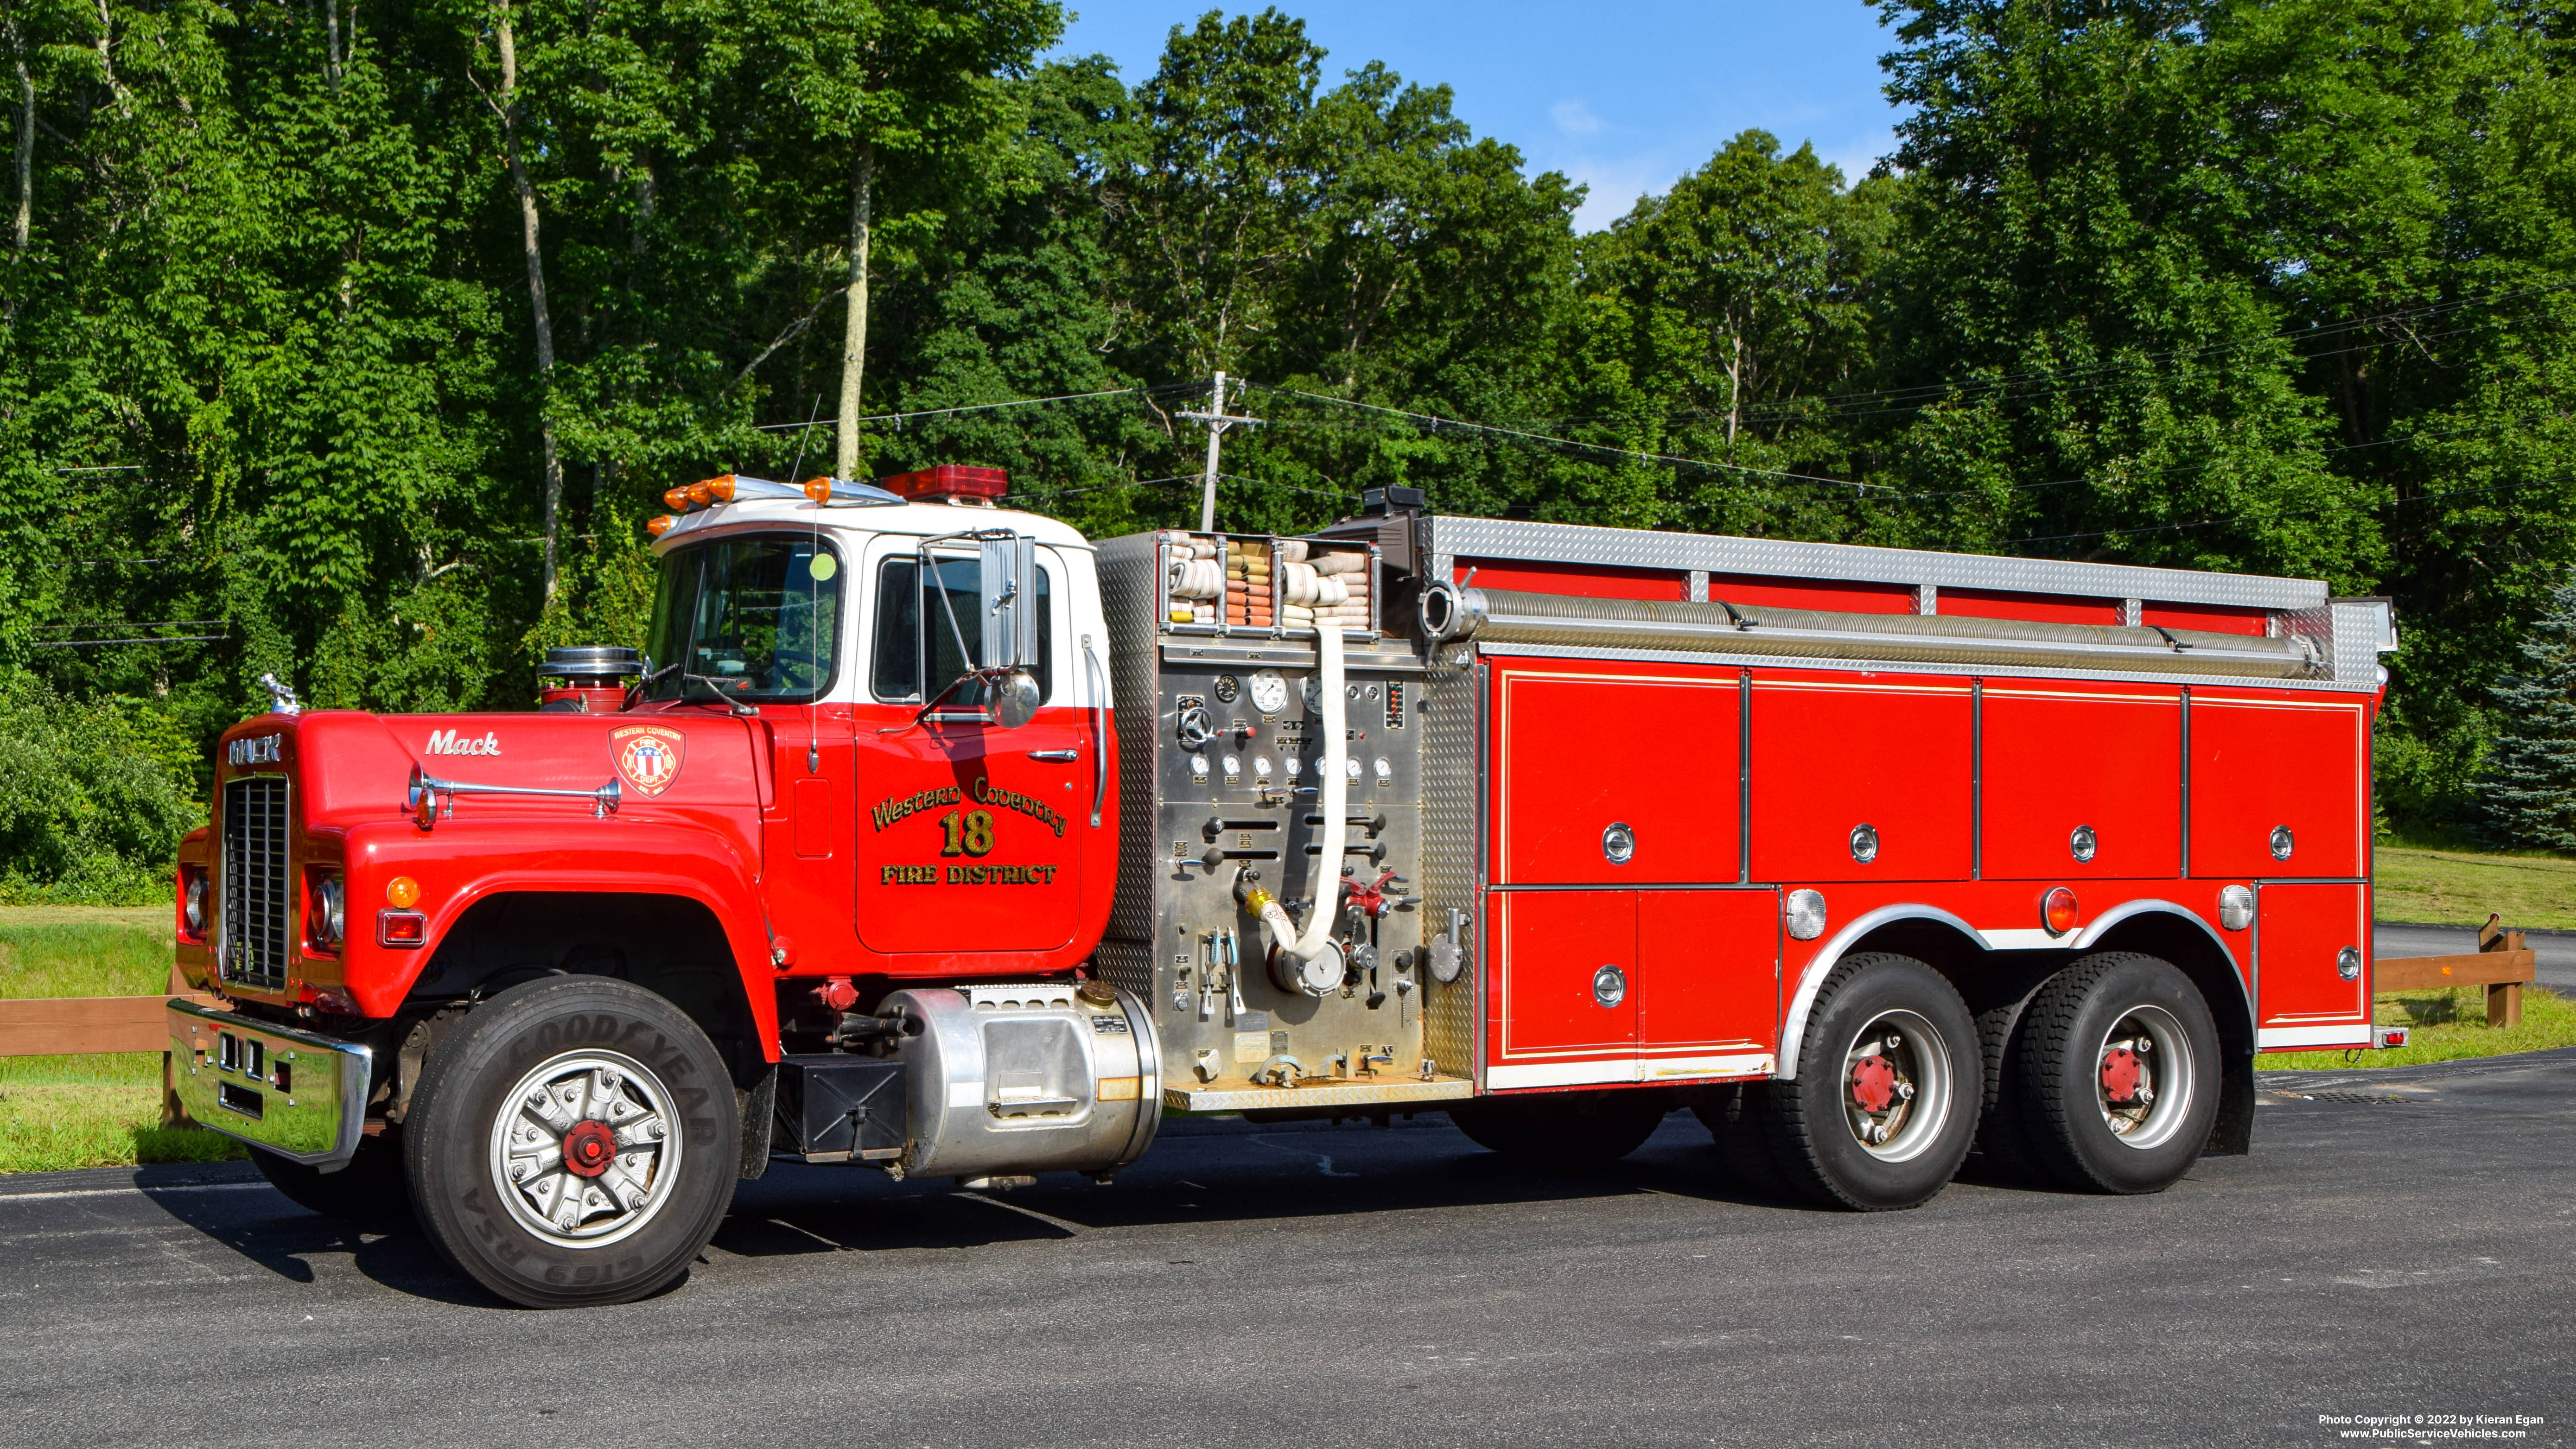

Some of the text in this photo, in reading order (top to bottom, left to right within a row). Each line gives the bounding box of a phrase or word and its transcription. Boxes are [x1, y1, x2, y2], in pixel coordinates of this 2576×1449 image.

[229, 732, 282, 766] MACK
[425, 729, 501, 756] Mack
[614, 727, 681, 741] WESTERN COVENTRY
[871, 776, 1067, 838] Western Coventry
[939, 809, 996, 858] 18
[880, 864, 1058, 886] FIRE DISTRICT
[507, 1014, 717, 1147] GOODYEAR
[462, 1185, 644, 1284] G169 RSA
